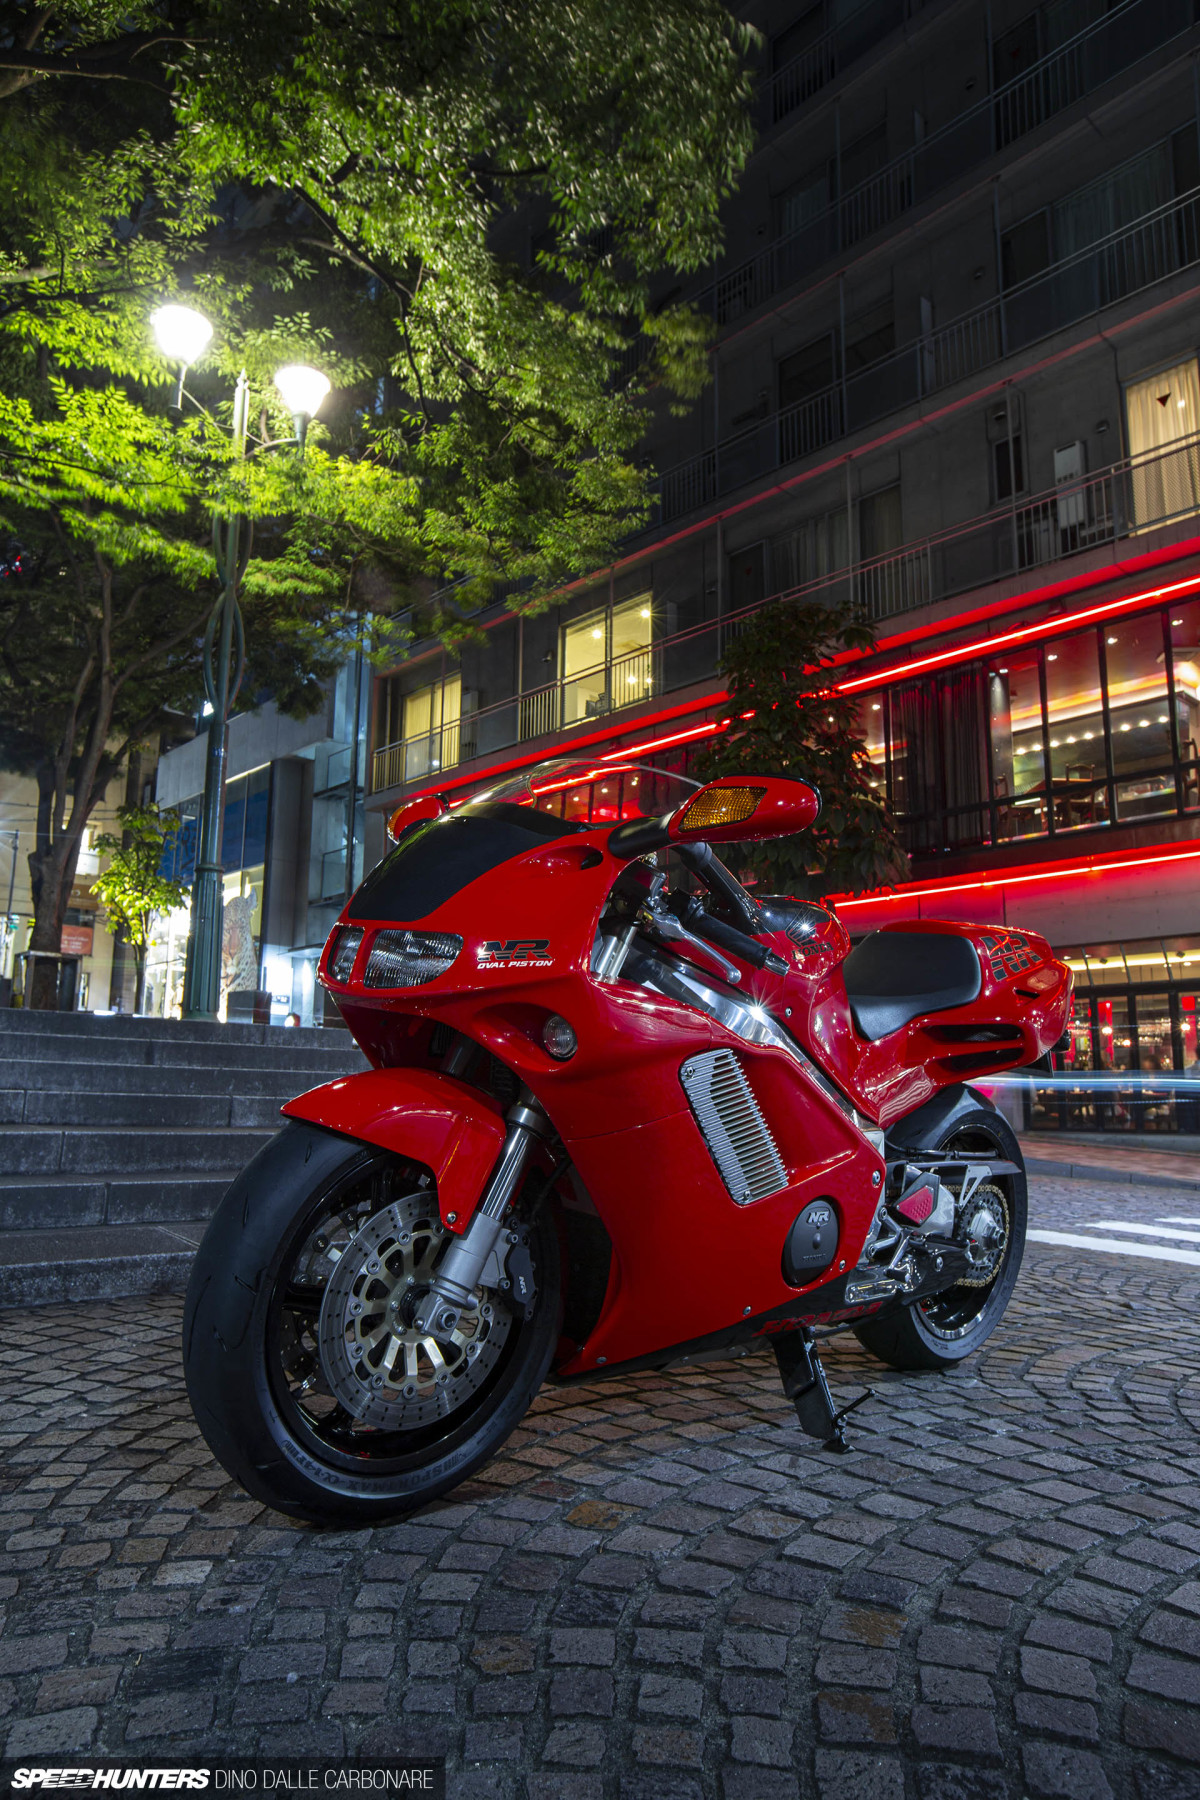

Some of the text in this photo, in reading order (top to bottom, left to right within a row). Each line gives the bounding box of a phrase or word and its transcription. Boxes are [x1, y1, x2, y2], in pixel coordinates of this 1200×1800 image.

[477, 939, 552, 961] NR
[477, 960, 553, 970] OVAL PISTON
[807, 1211, 829, 1223] NR
[751, 1301, 883, 1338] HONDA
